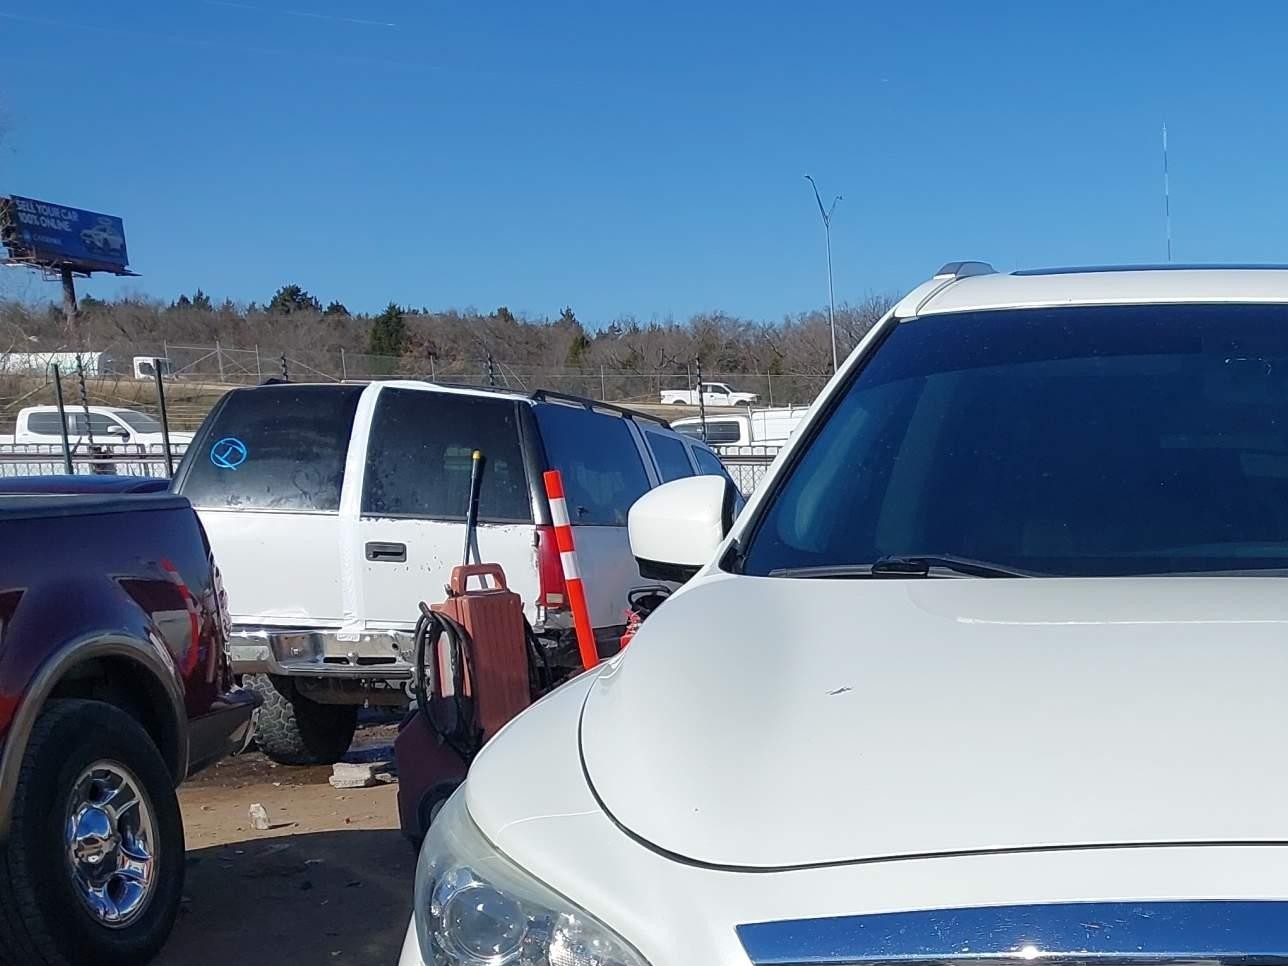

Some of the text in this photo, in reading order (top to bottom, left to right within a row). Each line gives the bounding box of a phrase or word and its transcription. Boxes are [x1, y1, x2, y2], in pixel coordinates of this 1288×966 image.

[16, 199, 79, 222] SELL YOUR CAR
[40, 216, 72, 232] ONLINE
